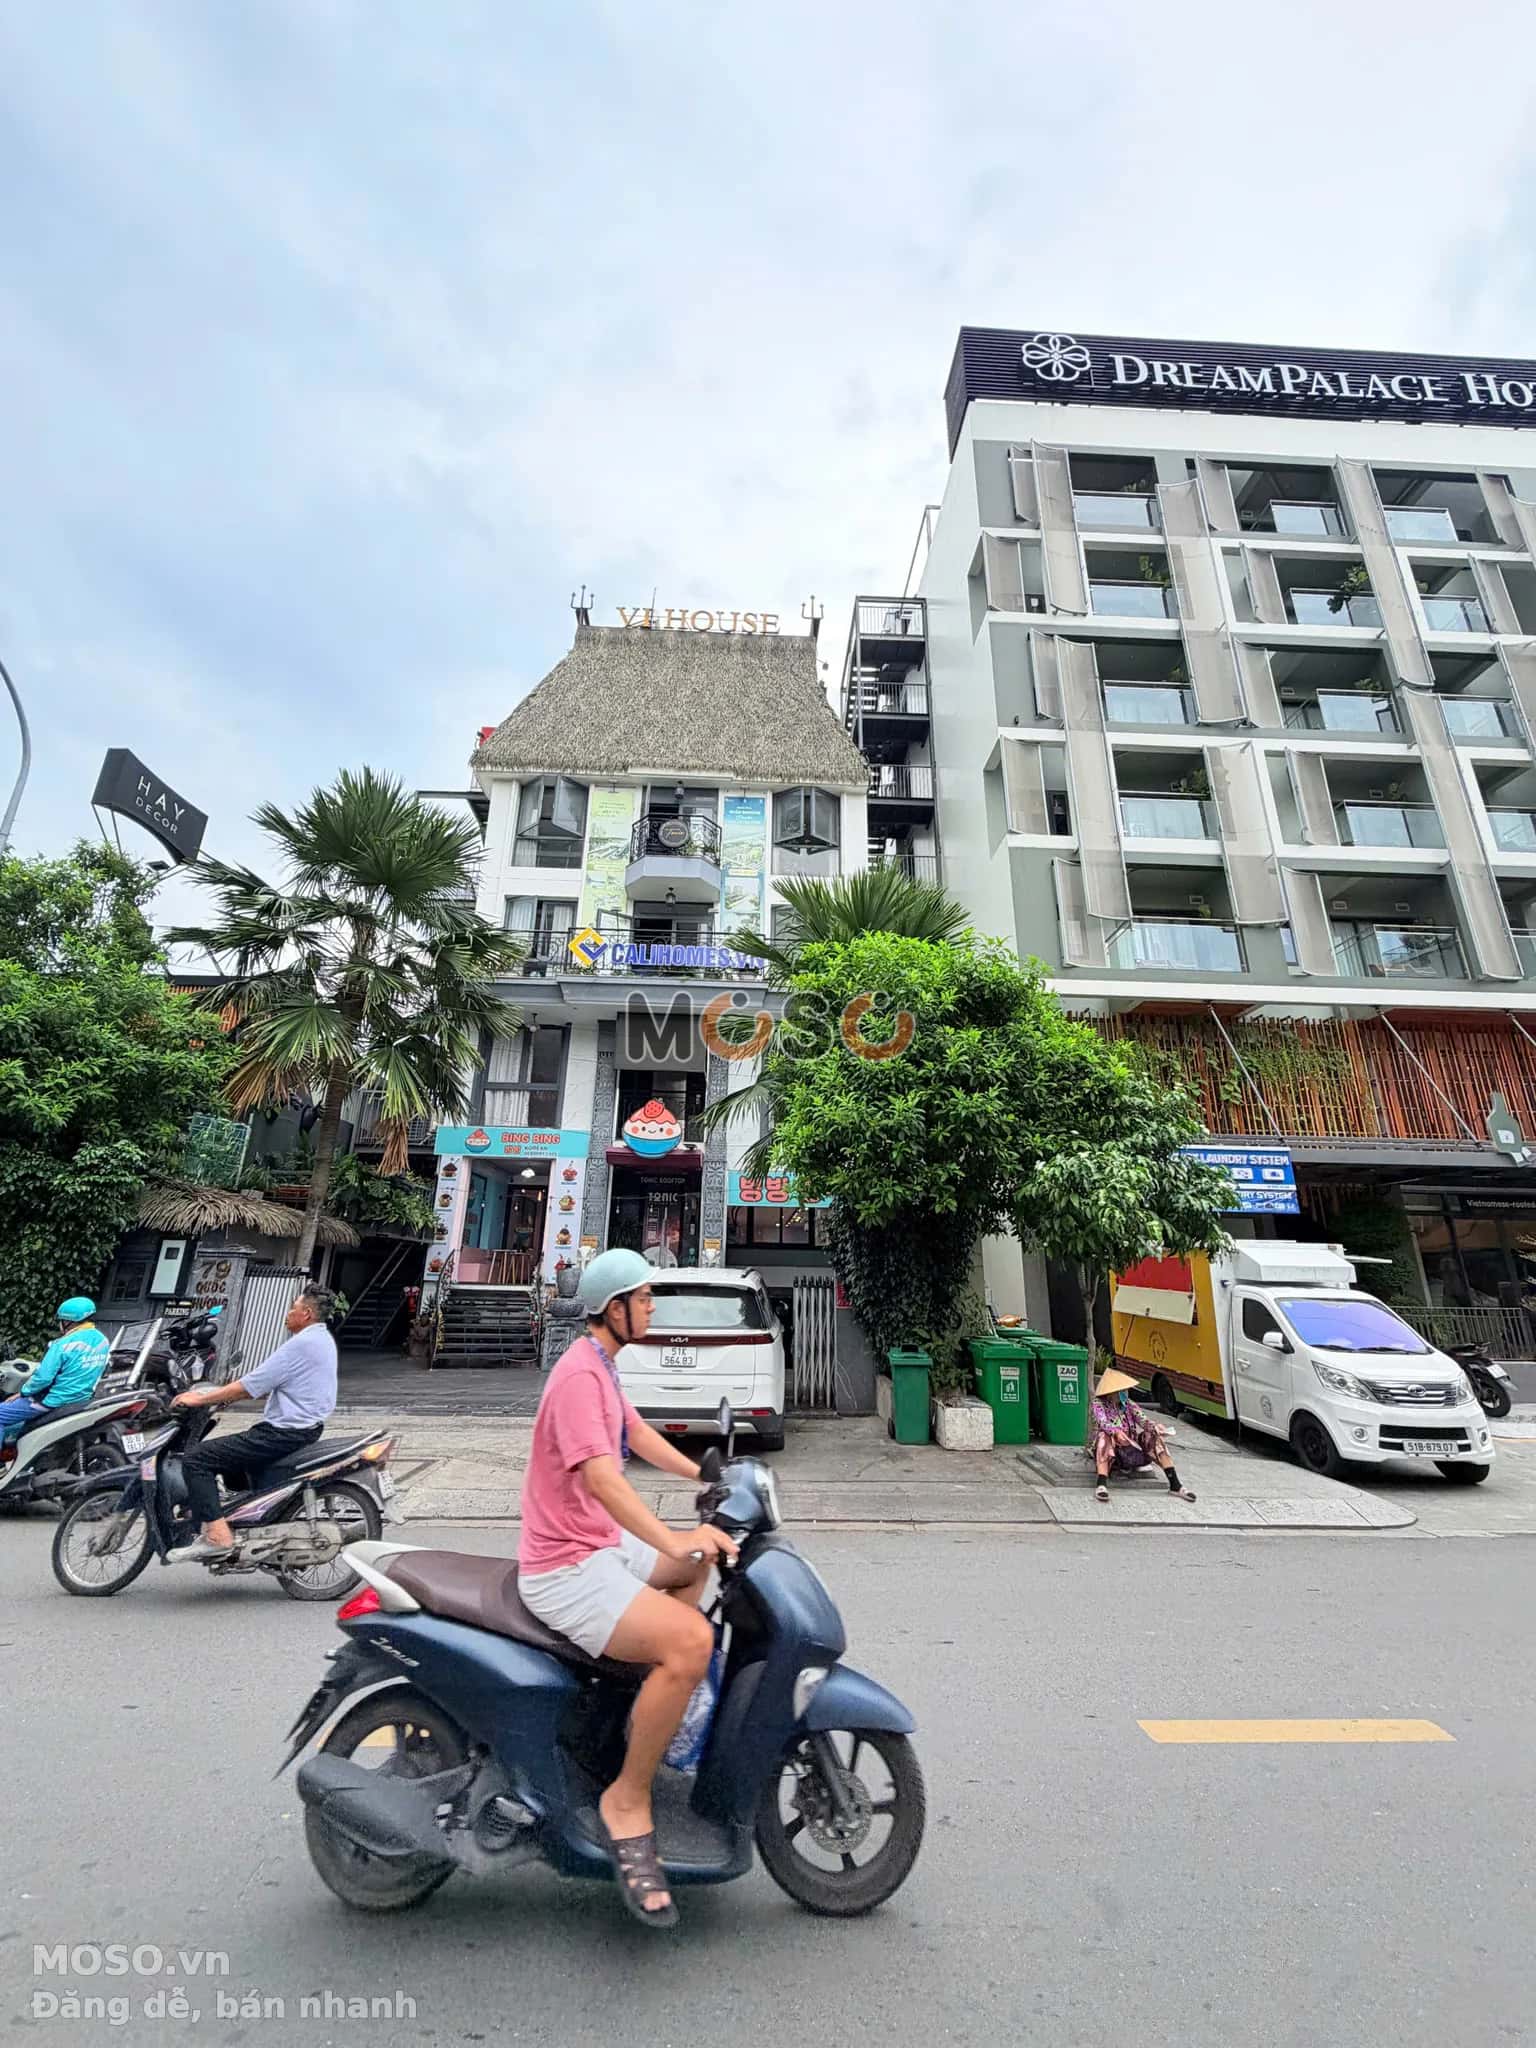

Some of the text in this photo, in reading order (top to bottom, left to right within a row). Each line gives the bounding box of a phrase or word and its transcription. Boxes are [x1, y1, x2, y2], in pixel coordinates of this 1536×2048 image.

[664, 608, 781, 636] HOUSE
[138, 775, 185, 821] HAY
[135, 796, 178, 835] DECOR
[501, 1132, 561, 1145] BING BING
[1201, 1153, 1248, 1165] LAUNDRY
[1249, 1155, 1289, 1165] SYSTEM
[201, 1259, 232, 1279] 79
[164, 1307, 191, 1316] PARKING
[671, 1347, 688, 1356] 51K
[1060, 1367, 1078, 1376] ZAO
